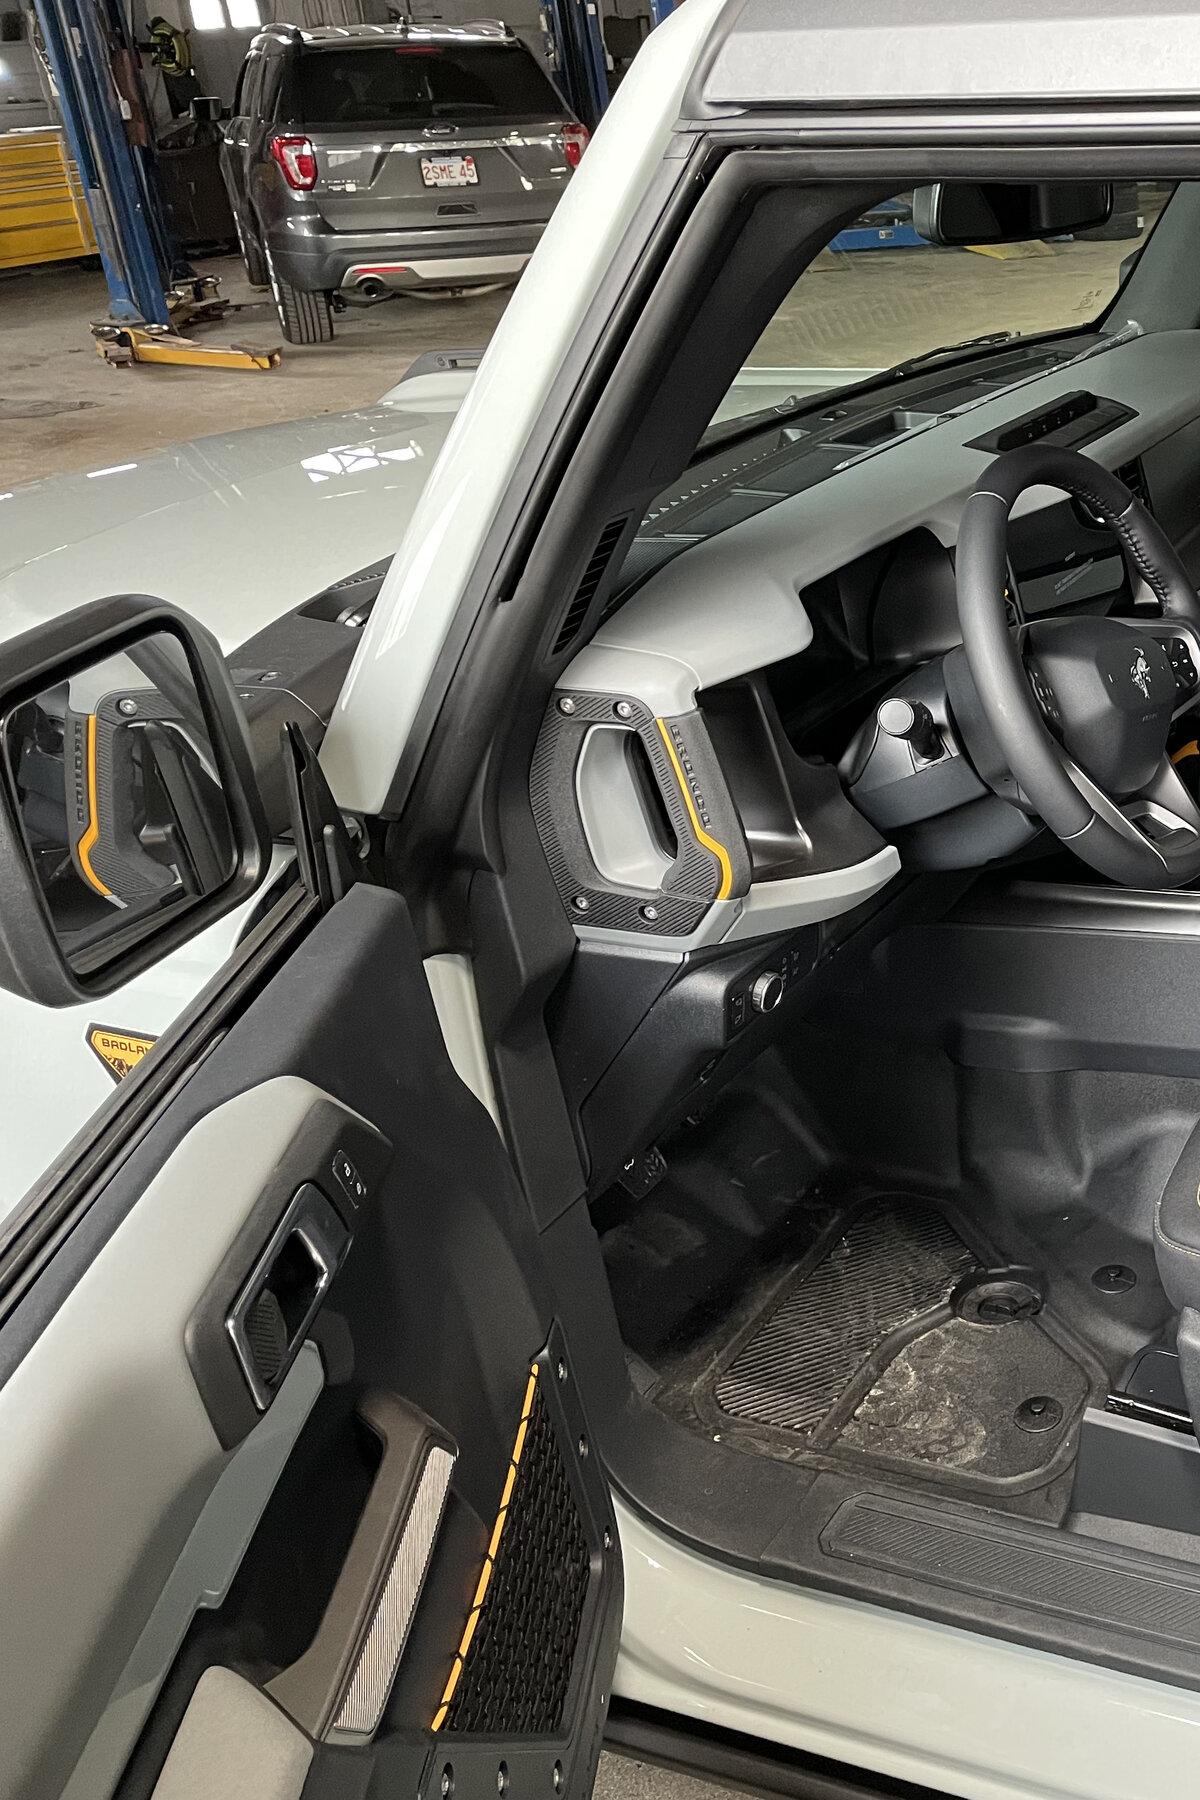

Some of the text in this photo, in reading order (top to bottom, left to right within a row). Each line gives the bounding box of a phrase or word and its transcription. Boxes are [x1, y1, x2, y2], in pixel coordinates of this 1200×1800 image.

[423, 164, 475, 180] 2SME 45
[670, 724, 712, 828] BRONCO
[101, 1038, 148, 1055] BADLA
